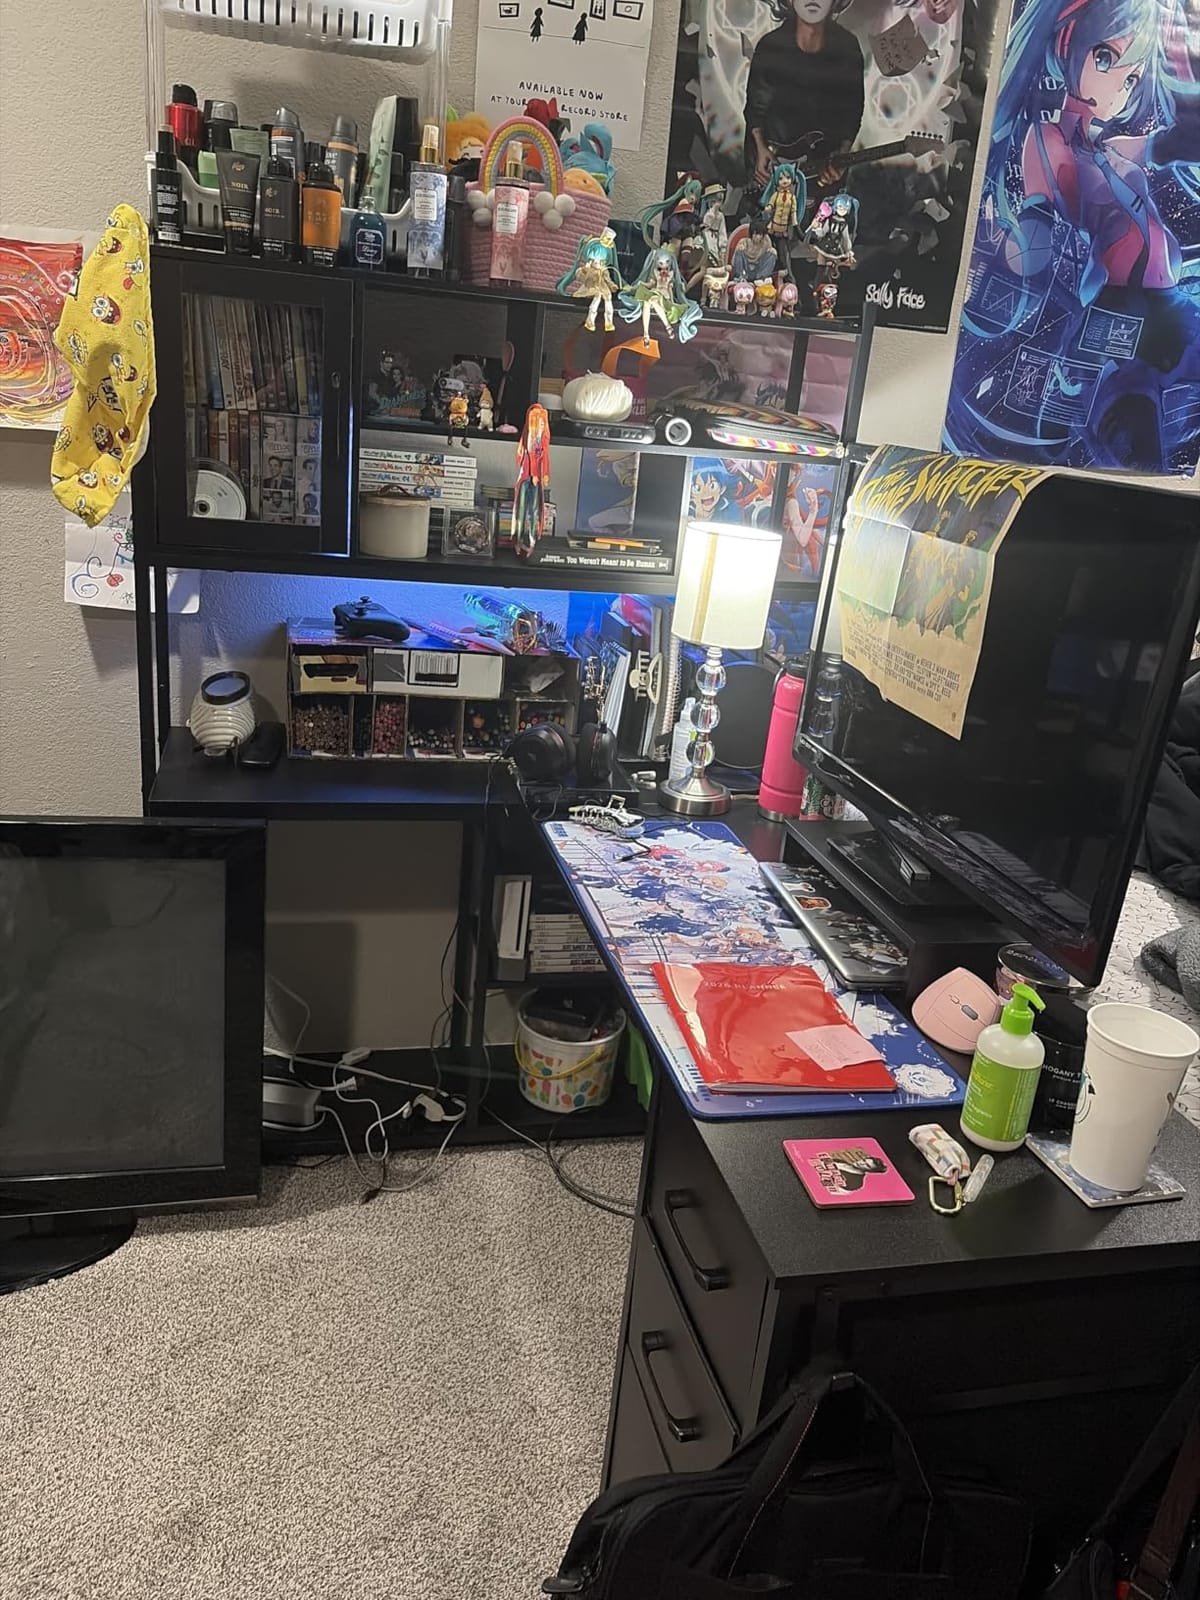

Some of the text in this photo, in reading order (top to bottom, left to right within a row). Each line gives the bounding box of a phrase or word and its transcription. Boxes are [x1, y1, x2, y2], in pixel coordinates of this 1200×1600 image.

[519, 81, 604, 101] AVAILABLE NOW
[490, 95, 628, 121] AT YOUR RECORD STORE
[865, 281, 926, 310] Sally Face
[891, 453, 1041, 520] SNATCHER
[566, 555, 577, 564] You
[578, 556, 600, 566] Weren't
[601, 557, 619, 566] Meant
[627, 559, 635, 567] Be
[636, 560, 656, 568] Human
